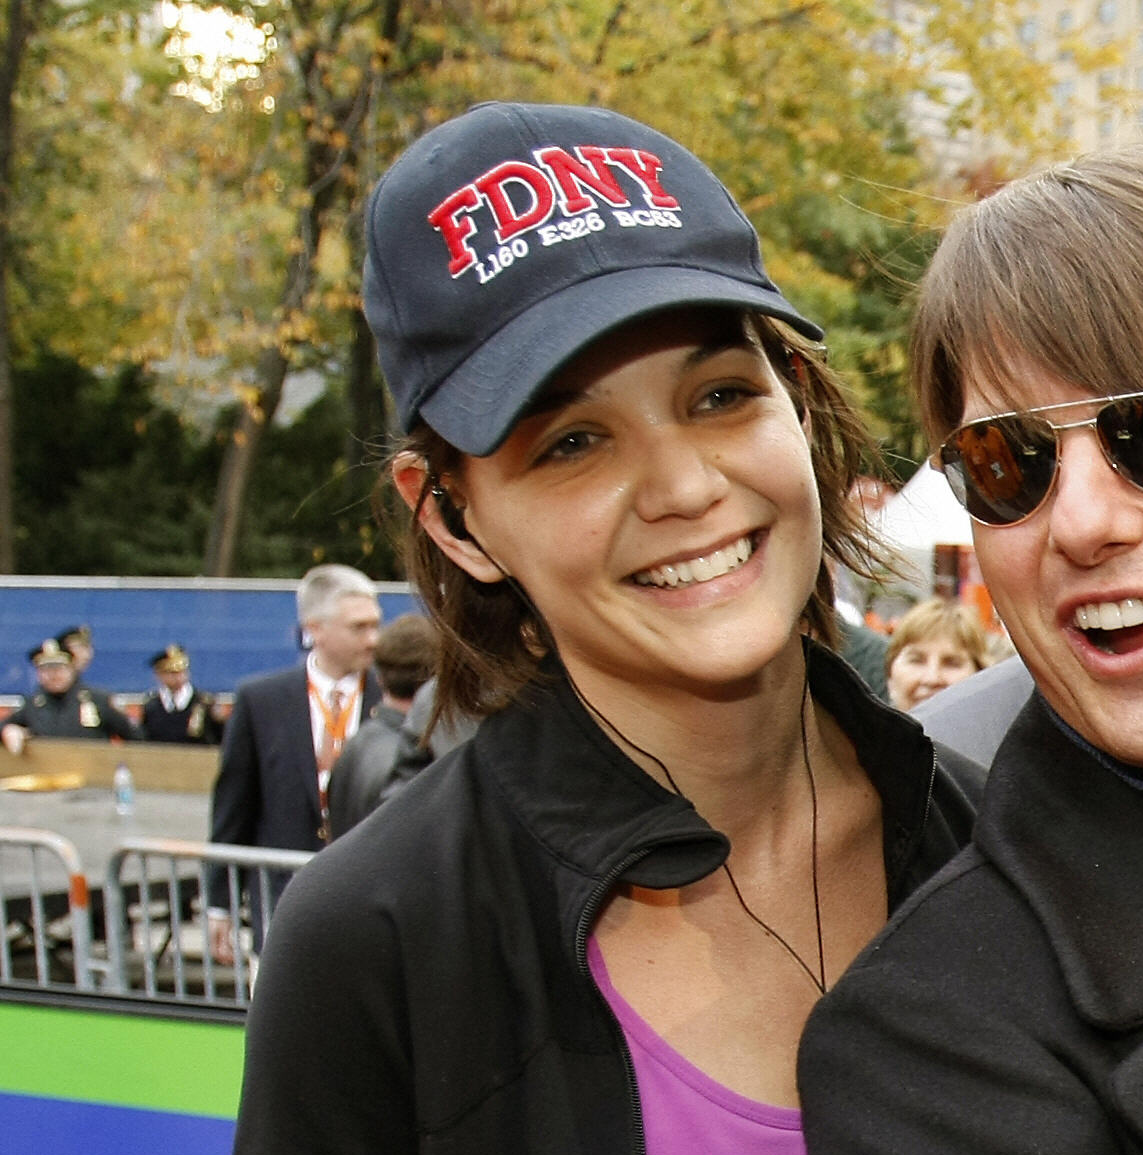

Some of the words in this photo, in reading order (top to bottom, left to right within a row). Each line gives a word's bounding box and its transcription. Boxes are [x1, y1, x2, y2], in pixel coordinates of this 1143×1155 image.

[427, 145, 682, 279] FDNY
[475, 238, 529, 284] L160
[537, 212, 605, 247] E326
